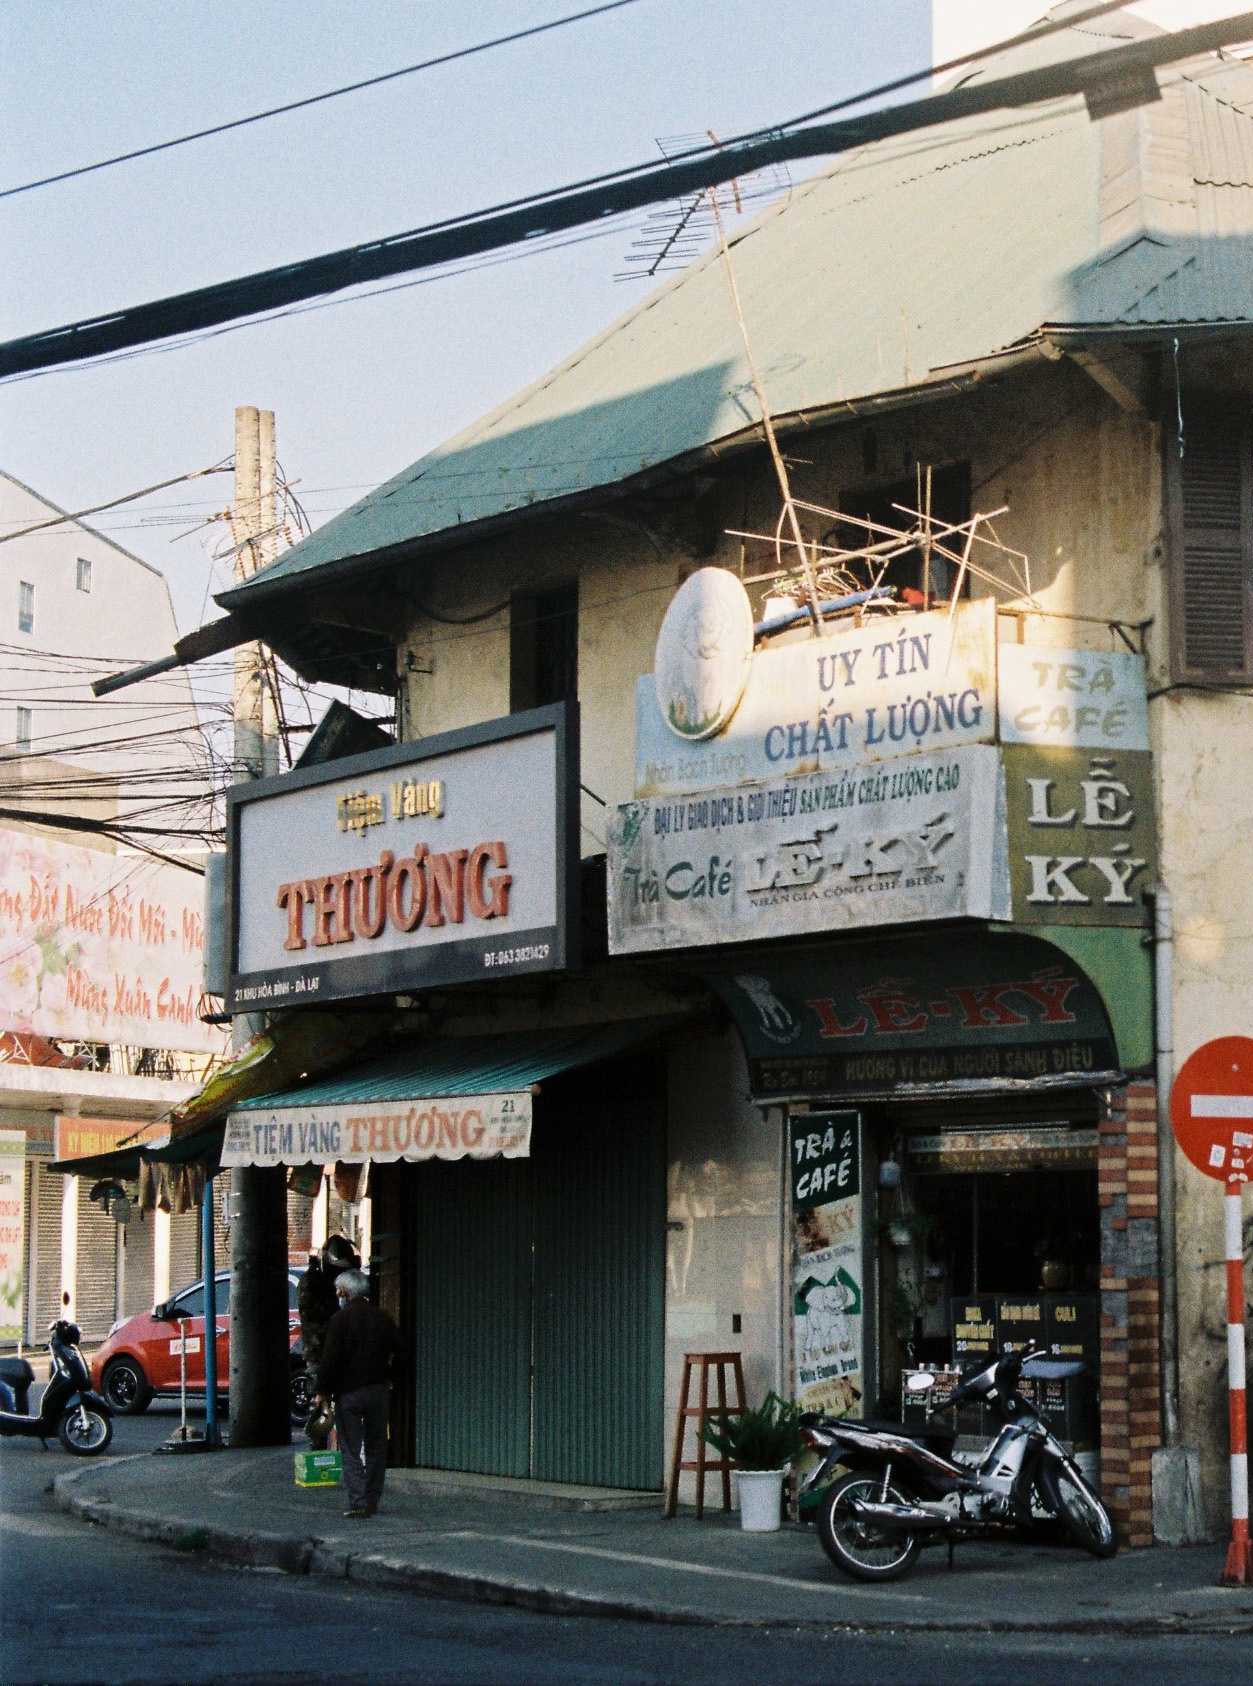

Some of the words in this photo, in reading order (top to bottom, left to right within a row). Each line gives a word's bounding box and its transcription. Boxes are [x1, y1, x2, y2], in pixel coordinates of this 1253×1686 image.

[818, 651, 868, 692] UY
[872, 629, 932, 680] TÍN
[1032, 660, 1115, 694] TRÀ
[765, 699, 854, 761] CHẤT
[865, 689, 984, 752] LƯỢNG
[1014, 700, 1127, 738] CAFÉ
[390, 778, 444, 819] Vàng
[936, 763, 960, 793] CAO
[665, 856, 732, 900] Café
[1025, 843, 1146, 902] KÝ
[277, 841, 512, 951] THƯƠNG
[114, 970, 151, 1019] Xuân
[156, 976, 194, 1025] Canh
[235, 989, 243, 1002] 21
[254, 1116, 293, 1162] TIỆM
[299, 1114, 341, 1154] VÀNG
[346, 1106, 486, 1154] THƯƠNG
[501, 1100, 515, 1113] 21
[795, 1121, 835, 1164] TRÀ
[796, 1152, 851, 1199] CAFÉ
